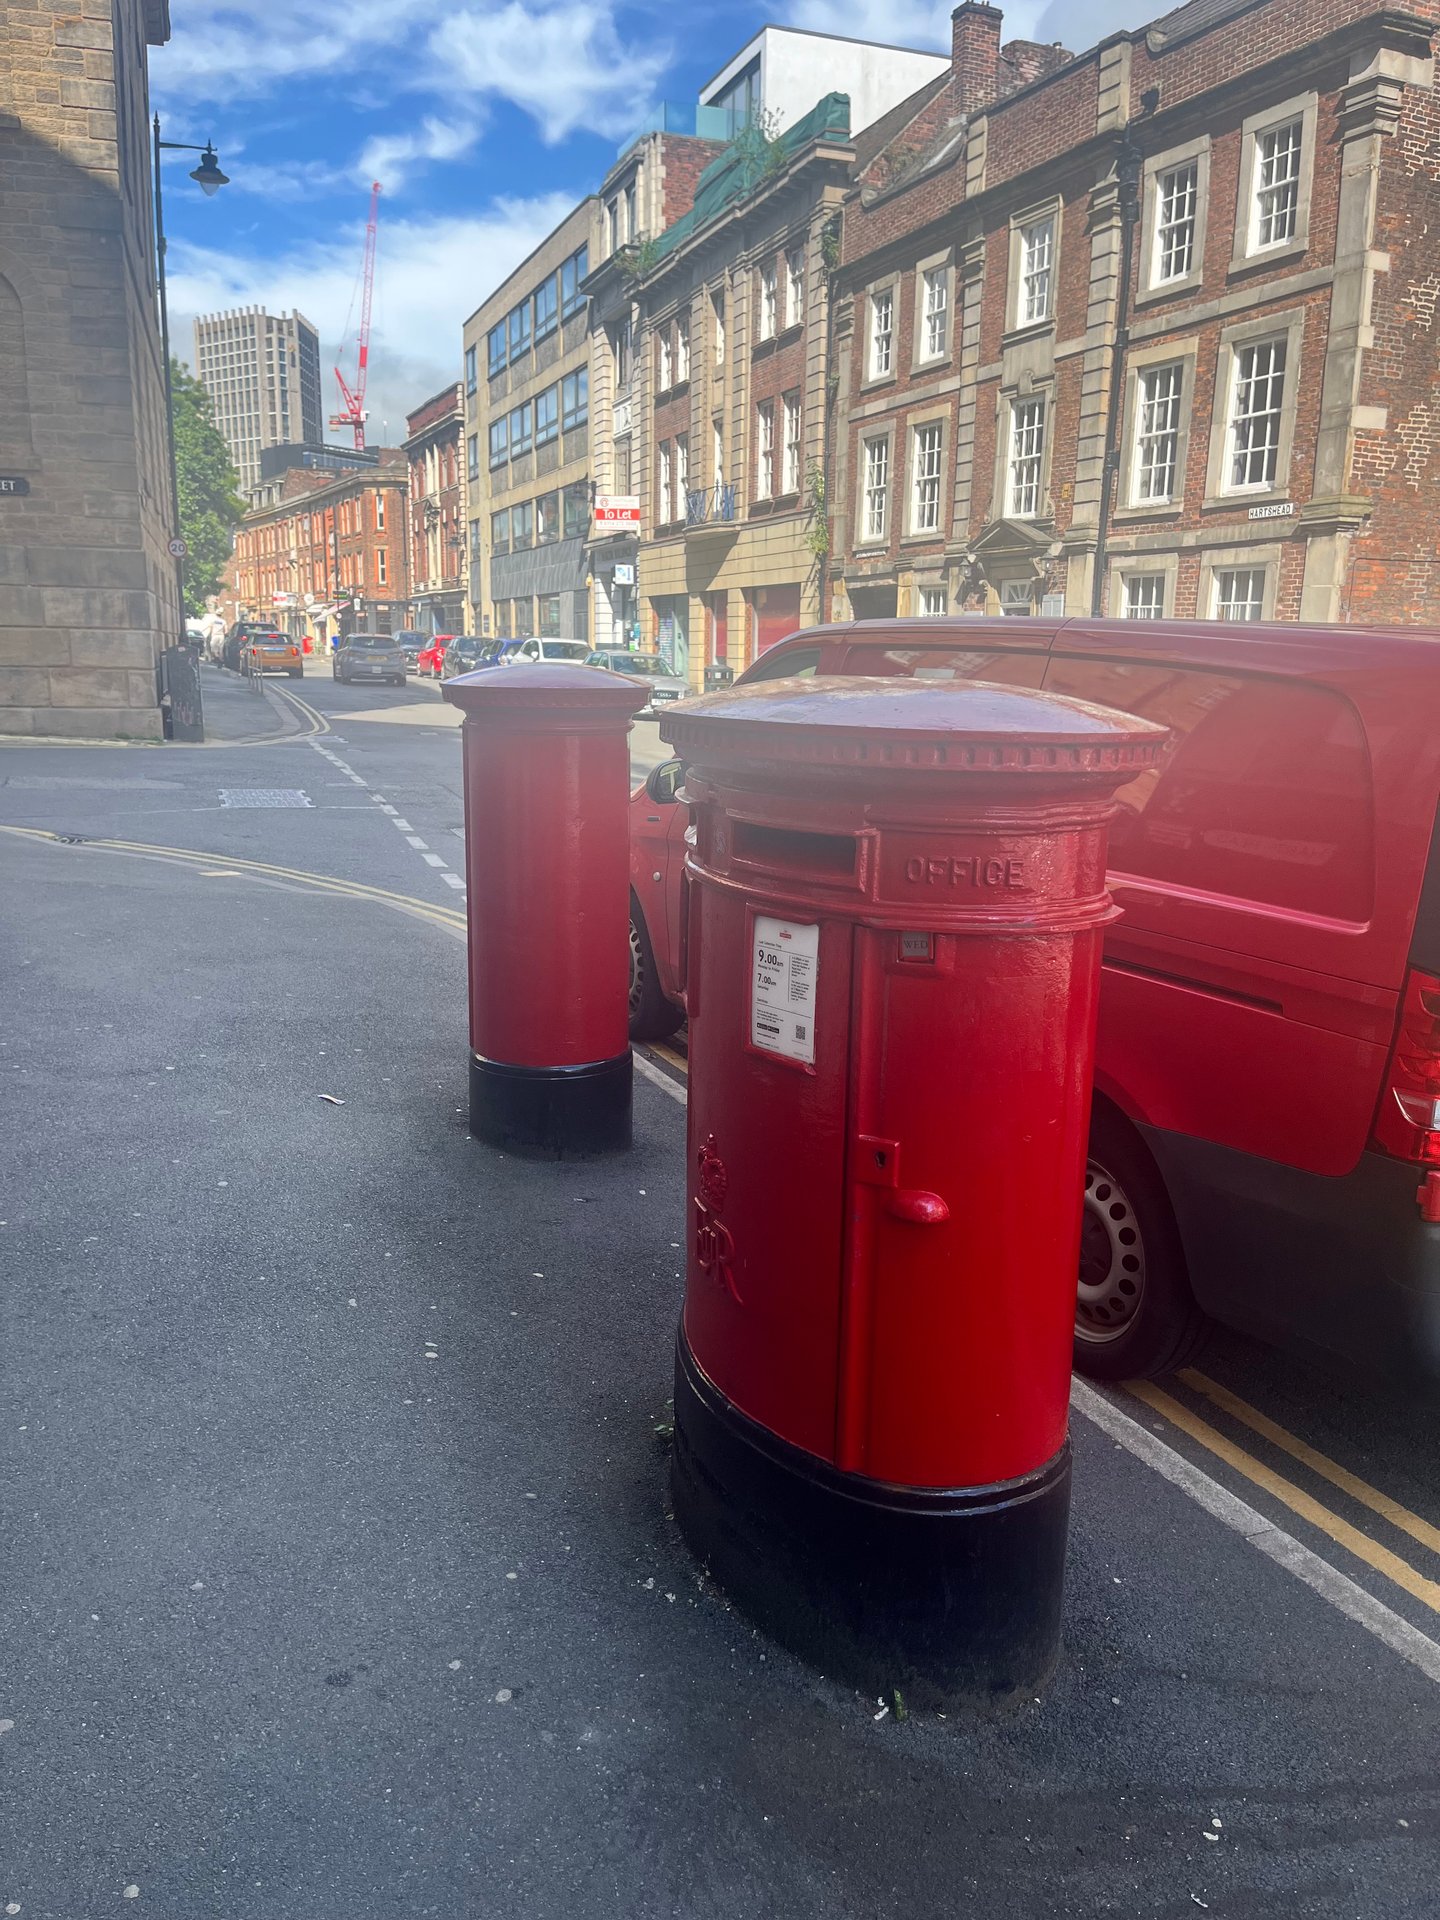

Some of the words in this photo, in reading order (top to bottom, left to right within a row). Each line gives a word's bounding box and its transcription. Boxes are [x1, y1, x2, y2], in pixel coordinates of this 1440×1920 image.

[0, 480, 15, 491] ET
[602, 508, 615, 519] To
[616, 508, 632, 519] Let
[1249, 504, 1291, 518] HARTSHEAD
[171, 543, 185, 552] 20
[906, 855, 1025, 890] OFFICE
[903, 939, 928, 950] WED
